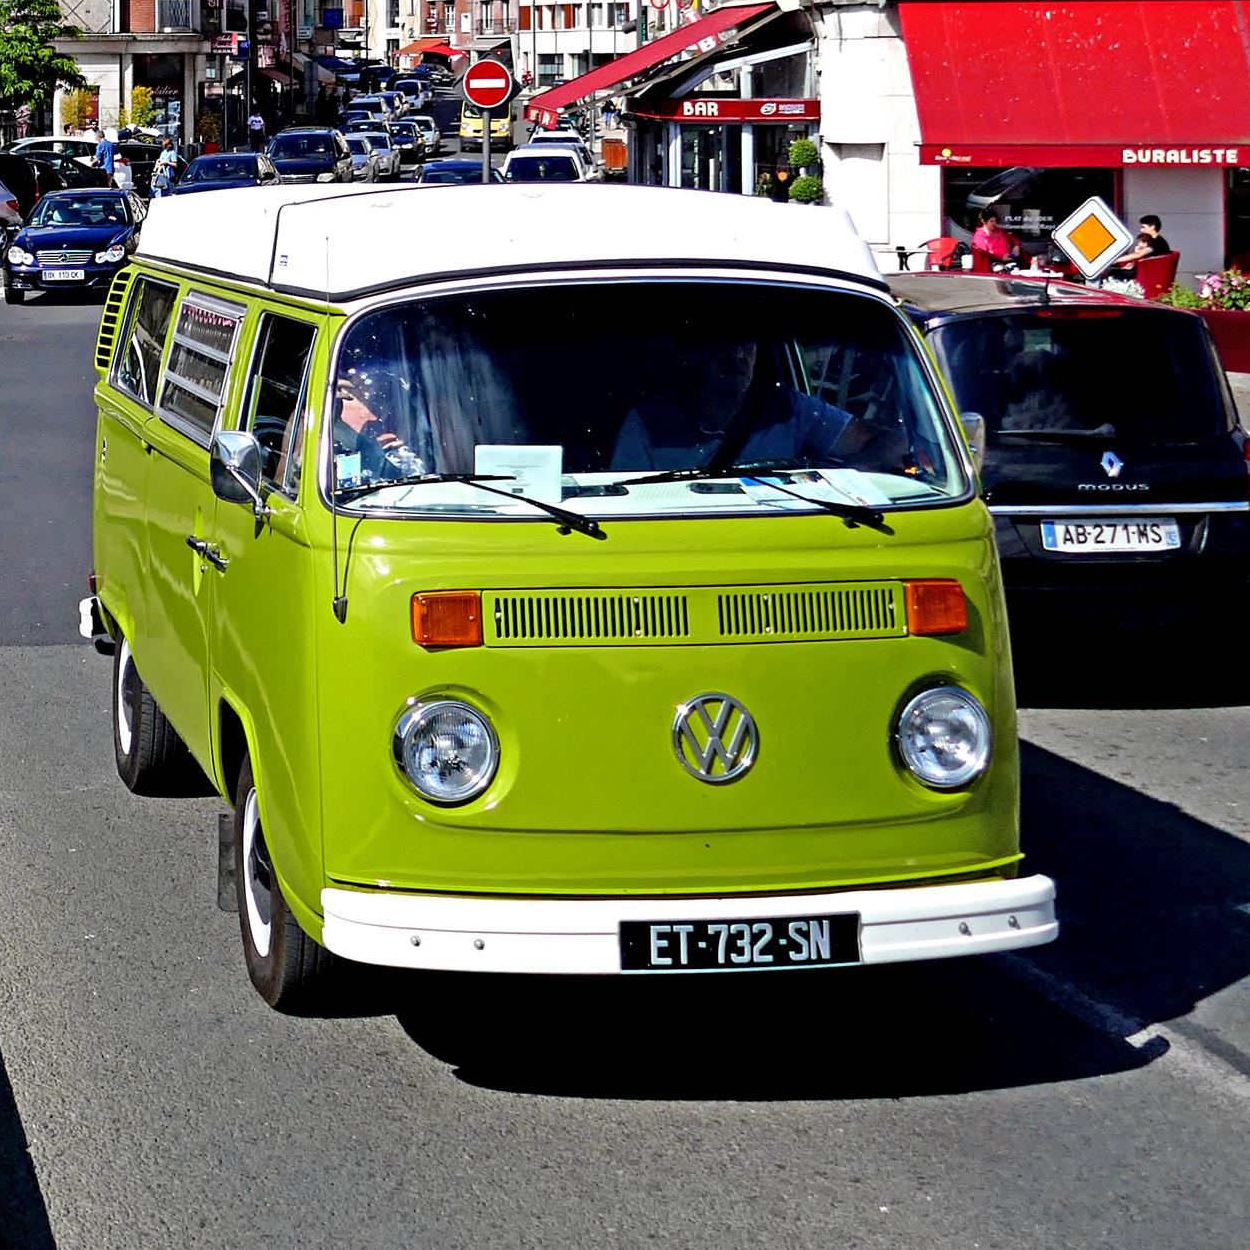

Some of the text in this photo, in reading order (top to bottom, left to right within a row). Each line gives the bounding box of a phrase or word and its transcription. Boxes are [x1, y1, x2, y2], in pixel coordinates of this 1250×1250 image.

[683, 102, 719, 116] BAR
[1122, 149, 1238, 163] BURALISTE
[650, 920, 831, 965] ET-732-SN
